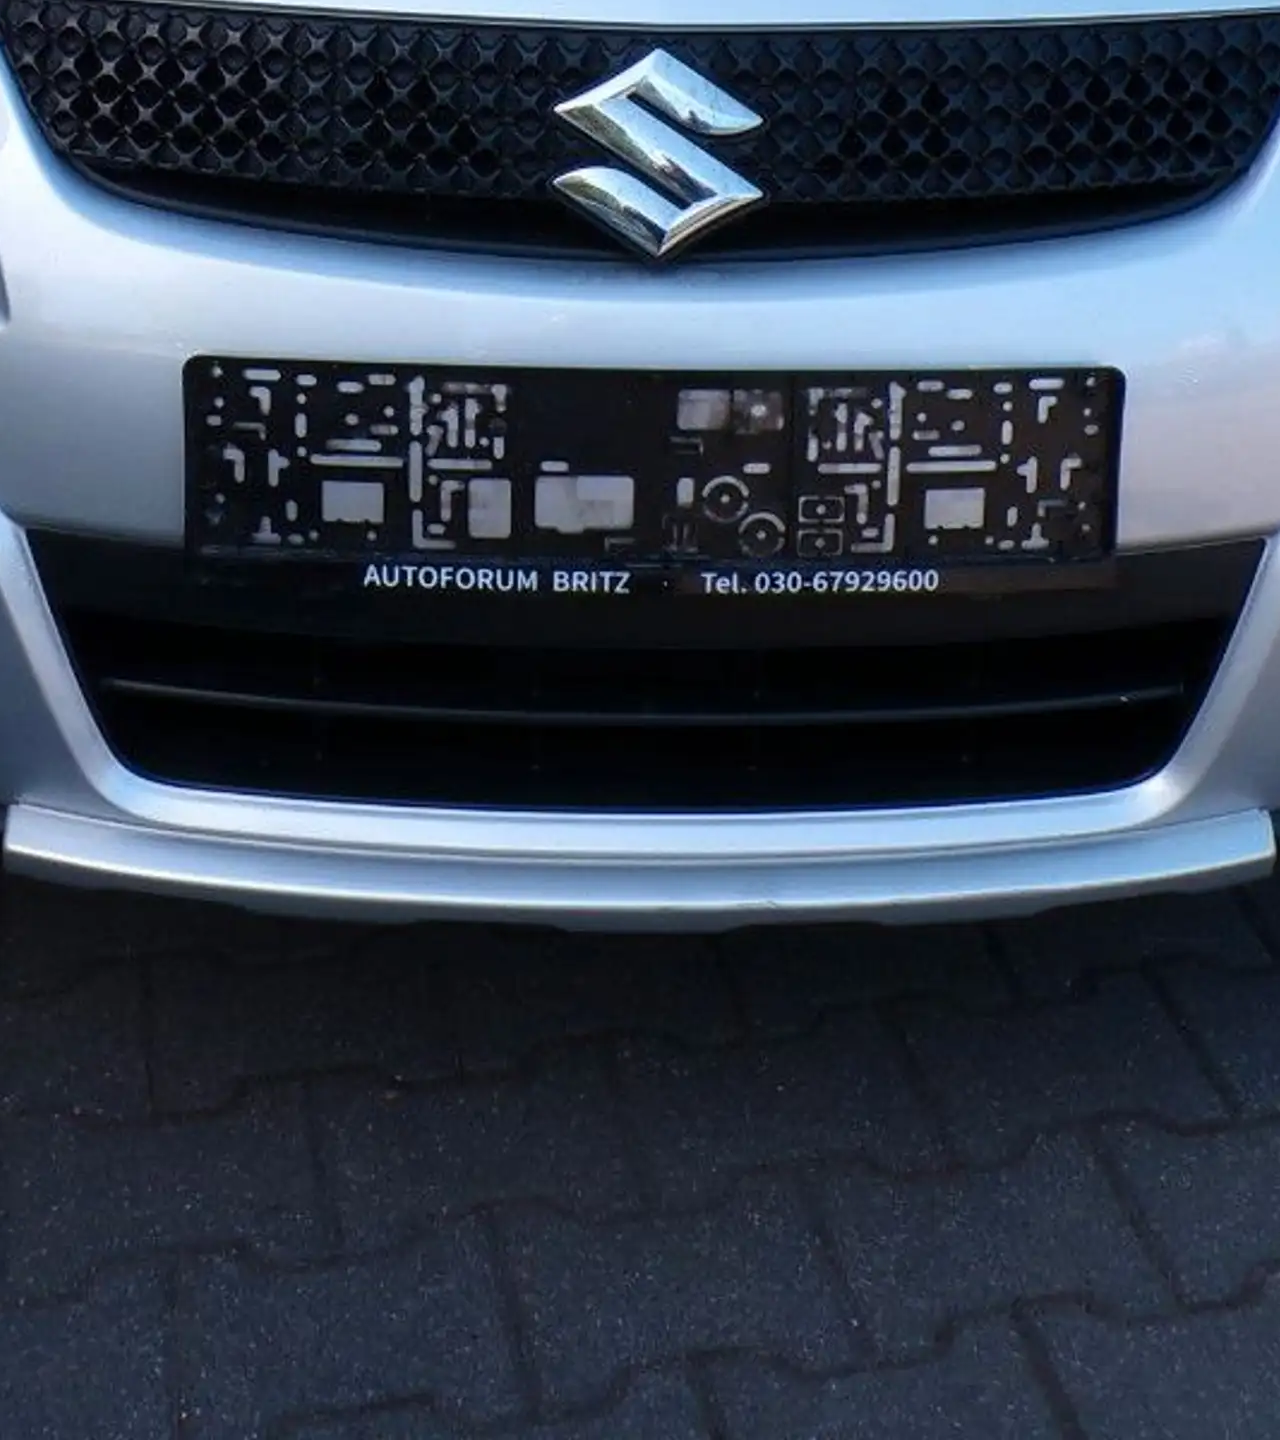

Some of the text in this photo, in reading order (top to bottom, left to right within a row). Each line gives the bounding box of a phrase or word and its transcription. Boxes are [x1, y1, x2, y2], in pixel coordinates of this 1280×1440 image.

[362, 565, 940, 594] AUTOFORUM BRITZ Tel. 030-67929600
